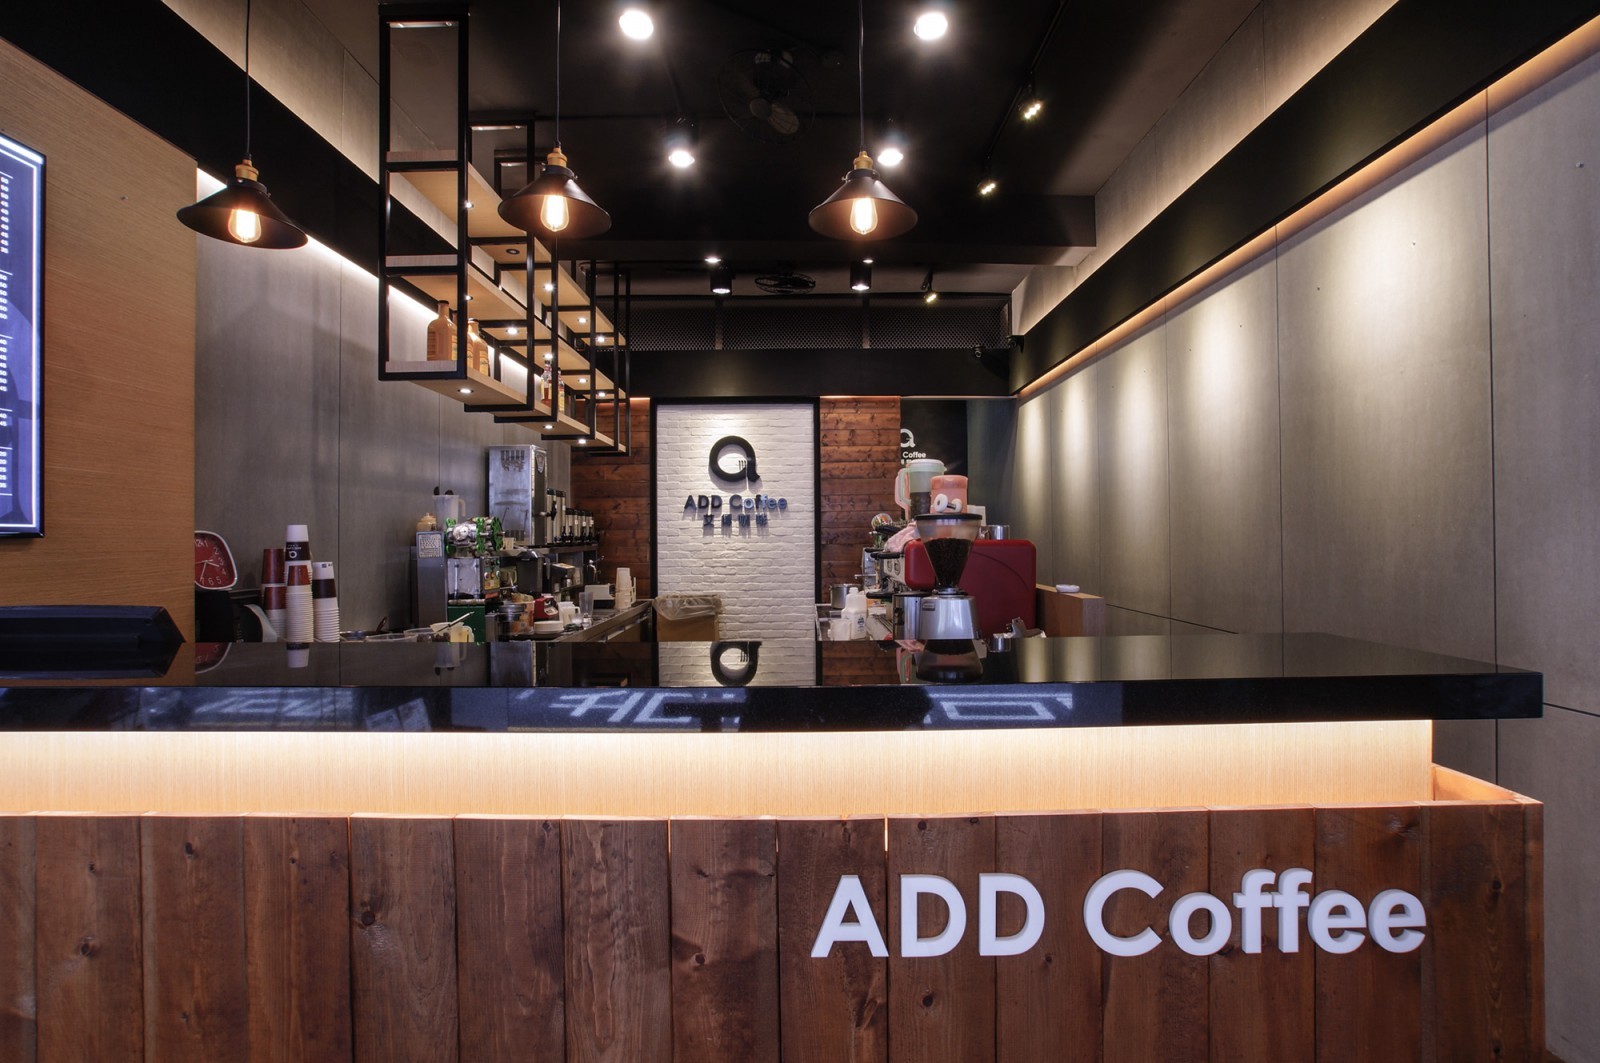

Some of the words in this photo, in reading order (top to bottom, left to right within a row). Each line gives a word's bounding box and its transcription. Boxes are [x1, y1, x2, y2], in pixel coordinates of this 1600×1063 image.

[902, 451, 927, 459] Coffee
[684, 494, 723, 510] ADD
[729, 493, 788, 510] Coffee
[810, 872, 1046, 958] ADD
[1083, 867, 1427, 957] Coffee
